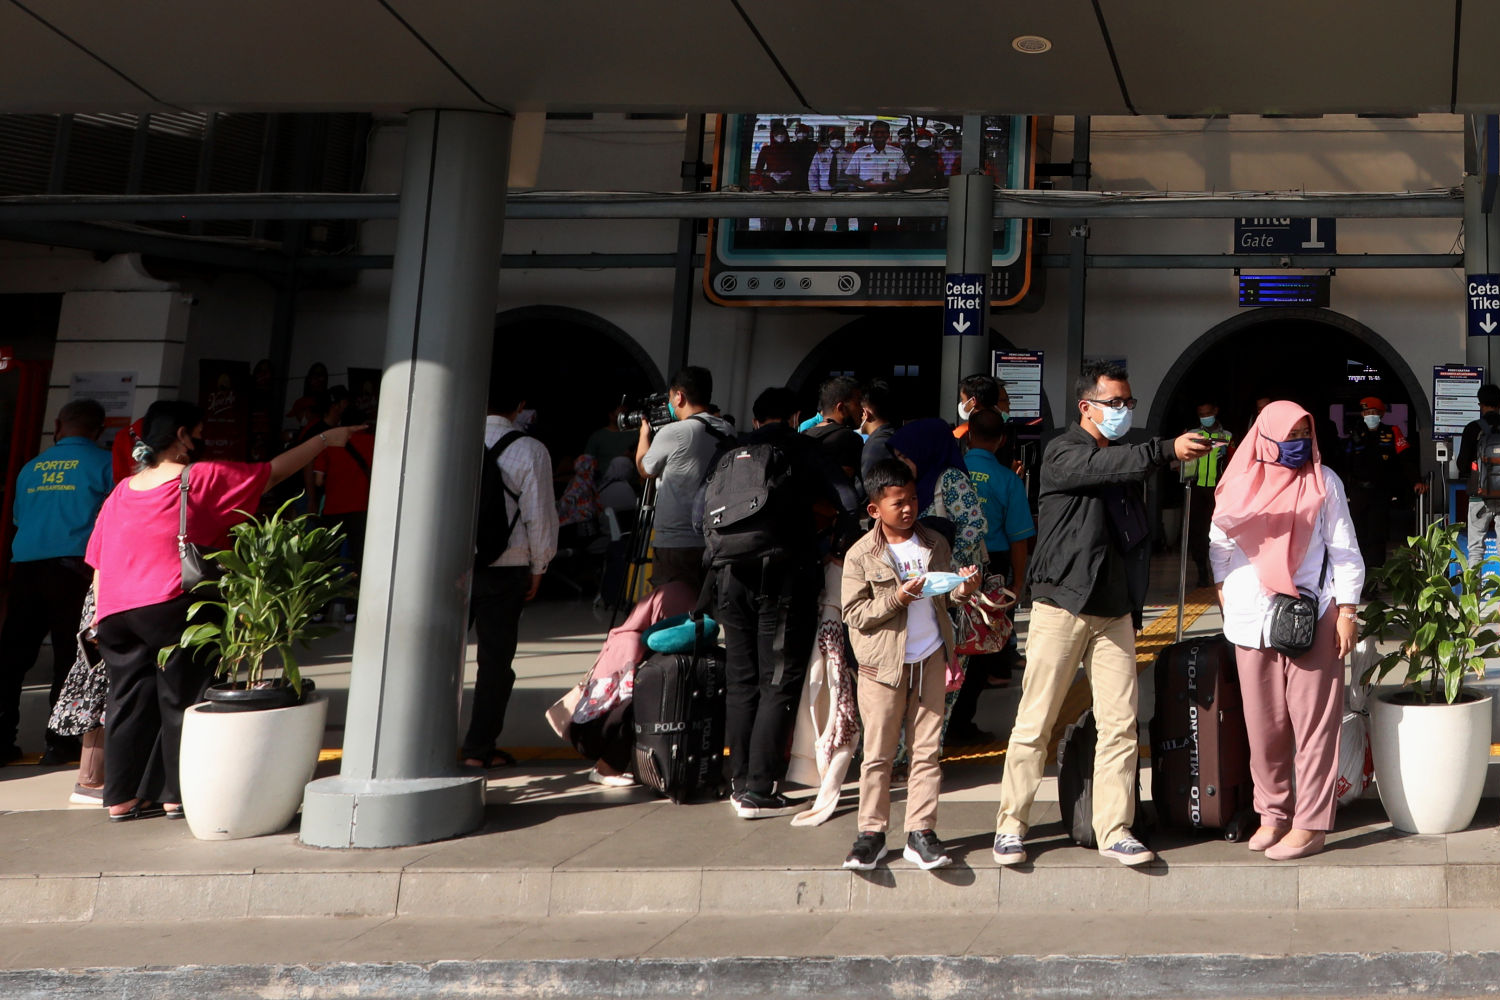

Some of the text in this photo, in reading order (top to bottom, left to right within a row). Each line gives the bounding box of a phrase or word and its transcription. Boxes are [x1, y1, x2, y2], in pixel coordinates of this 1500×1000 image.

[1240, 232, 1275, 248] Gate
[945, 281, 984, 295] Cetak
[947, 296, 980, 310] Tiket
[33, 459, 80, 472] PORTER
[41, 471, 65, 484] 145
[1187, 646, 1199, 691] POLO
[654, 721, 686, 733] POLO
[1189, 706, 1199, 776] MILANO
